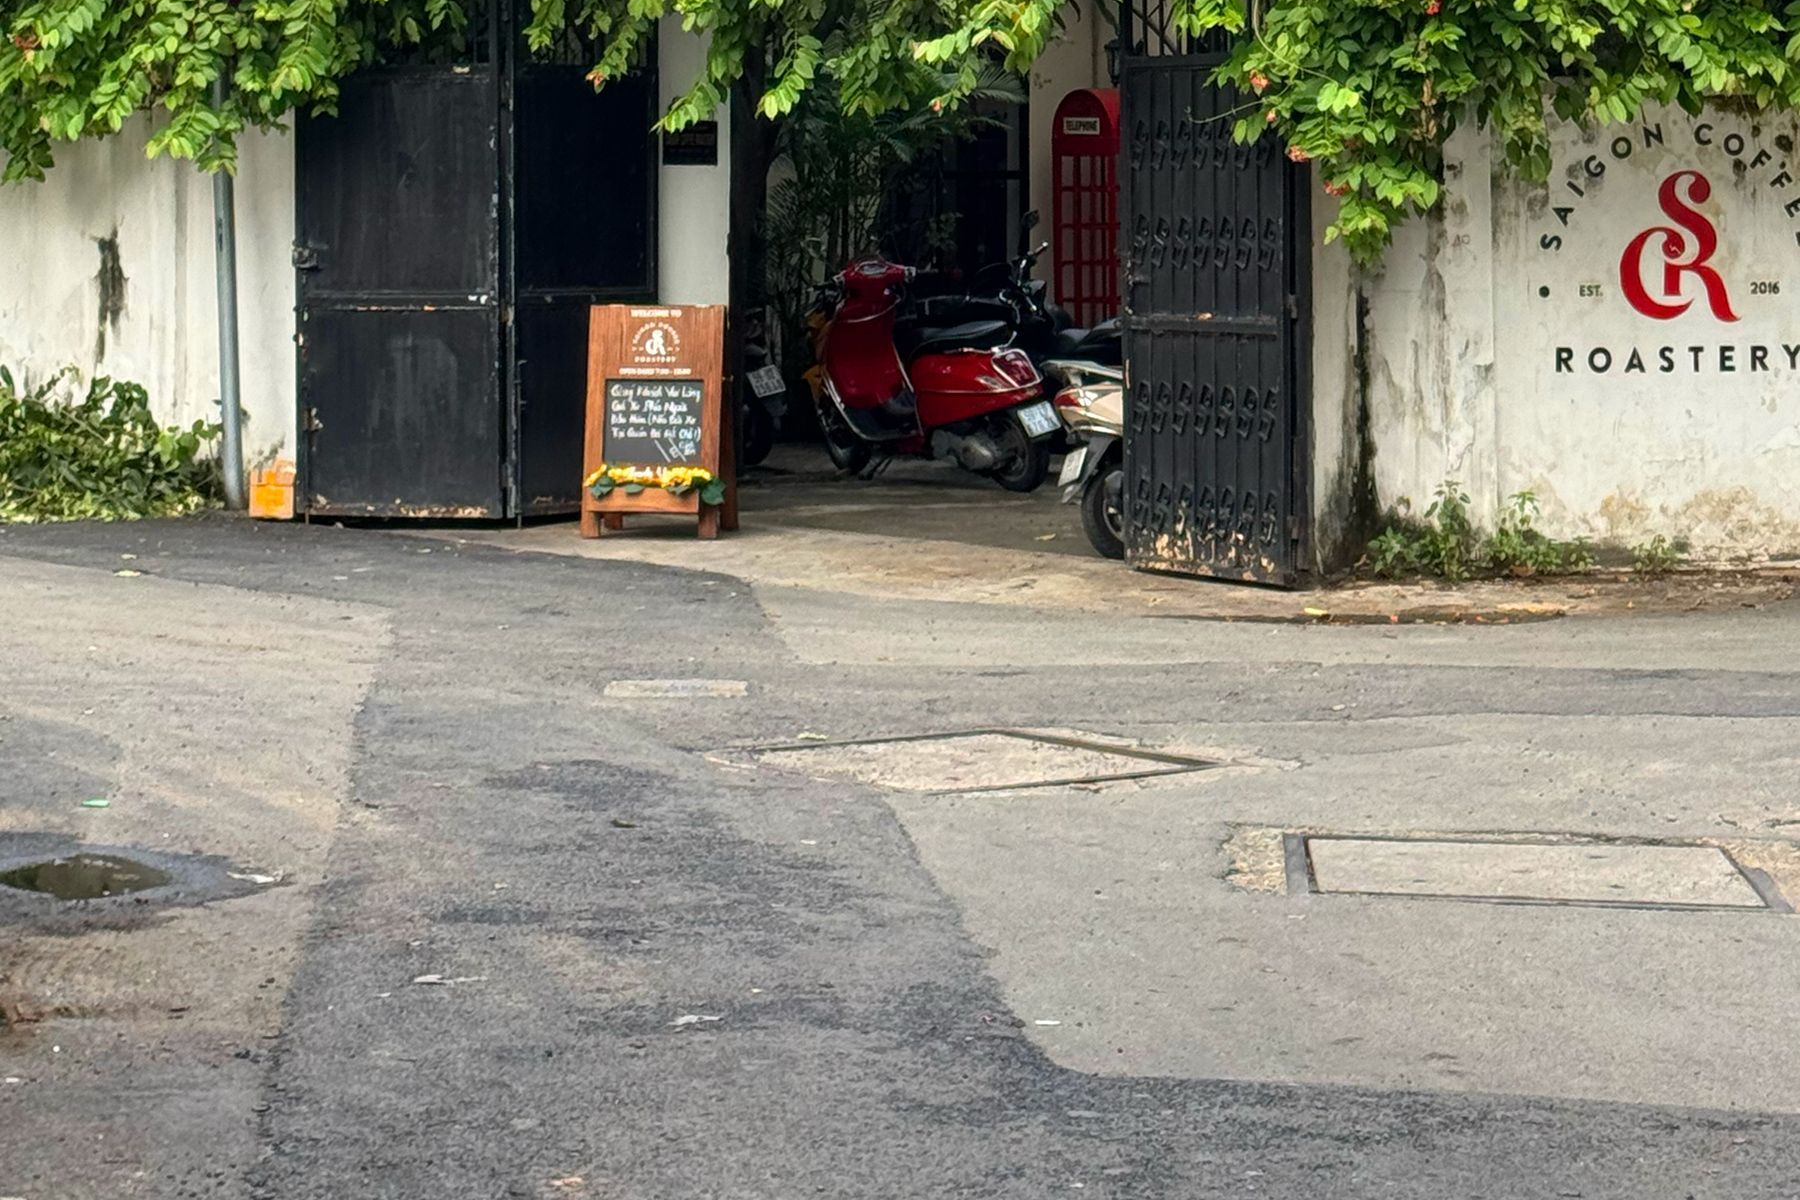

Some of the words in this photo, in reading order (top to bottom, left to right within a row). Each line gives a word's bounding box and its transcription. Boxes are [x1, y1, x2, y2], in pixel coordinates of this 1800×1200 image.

[1066, 120, 1097, 131] TELEPHONE
[1540, 123, 1664, 252] SAIGON
[1694, 123, 1800, 247] COFFE
[1579, 284, 1604, 298] EST.
[1750, 281, 1780, 295] 2016
[1555, 343, 1800, 373] ROASTERY
